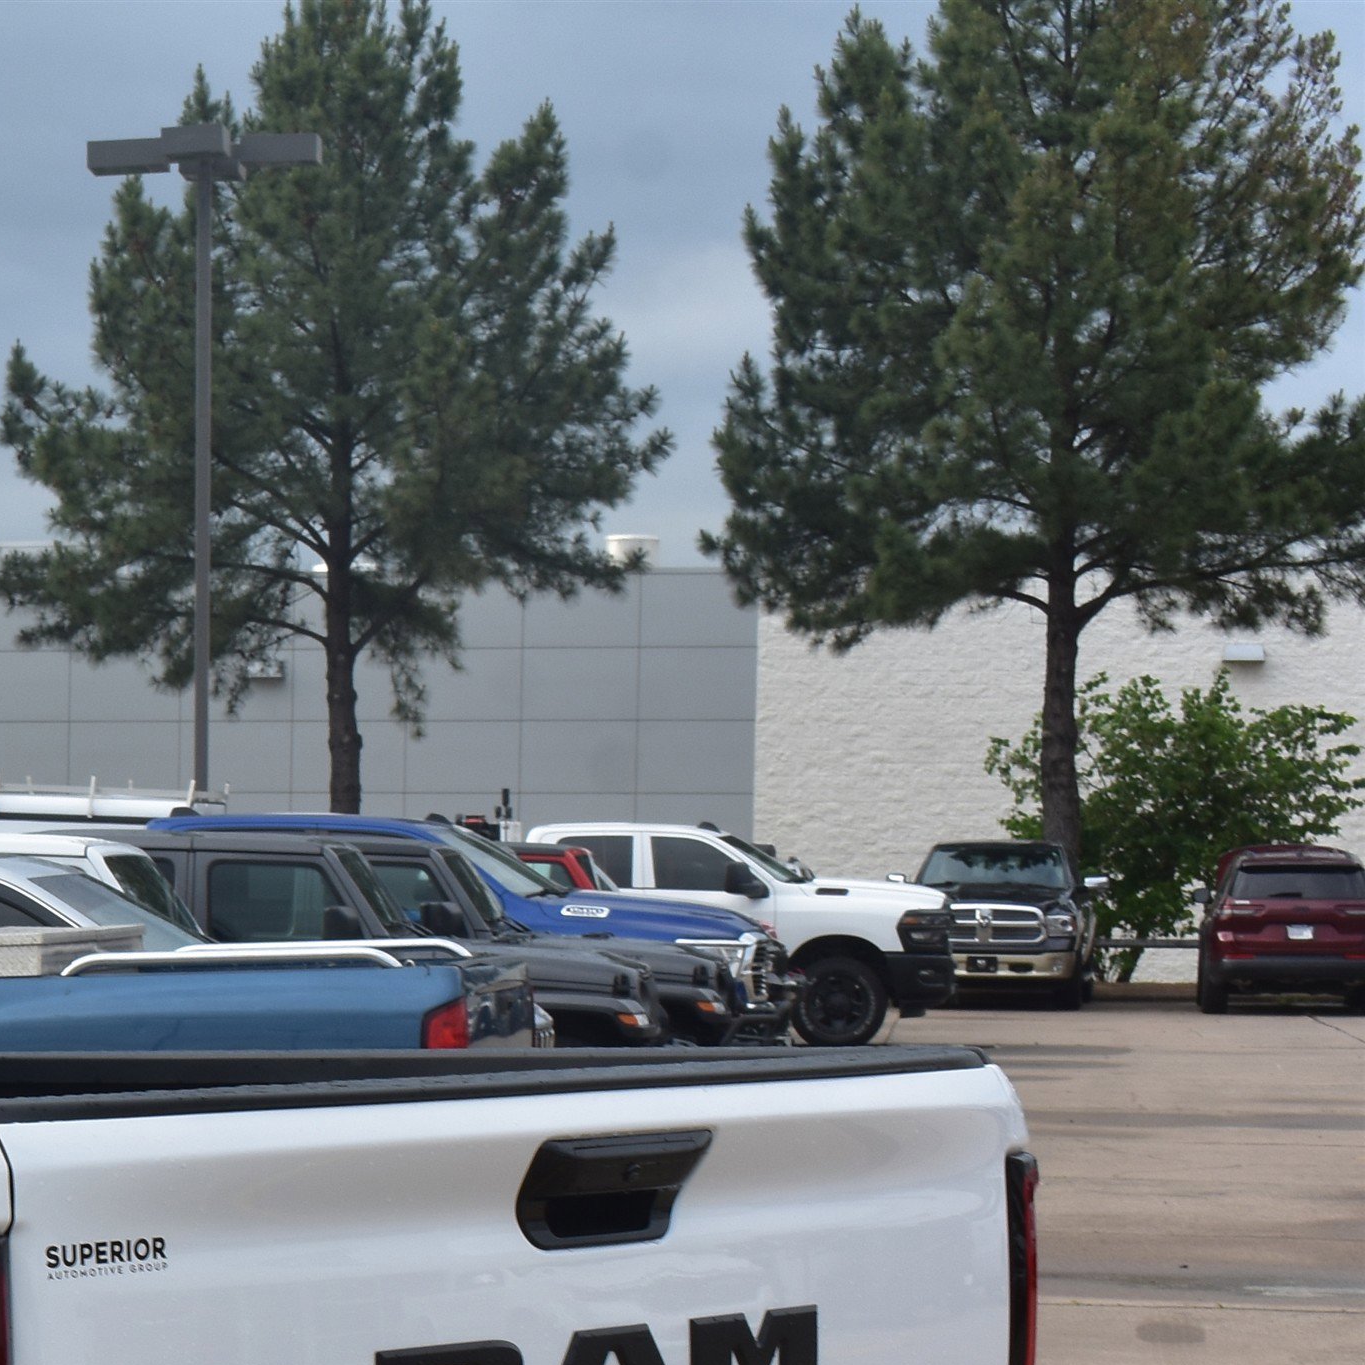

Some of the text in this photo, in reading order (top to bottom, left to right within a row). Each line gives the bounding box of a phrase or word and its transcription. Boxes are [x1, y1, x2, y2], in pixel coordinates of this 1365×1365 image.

[45, 1236, 168, 1269] SUPERIOR
[47, 1261, 169, 1281] AUTOMOTIVE GROUP
